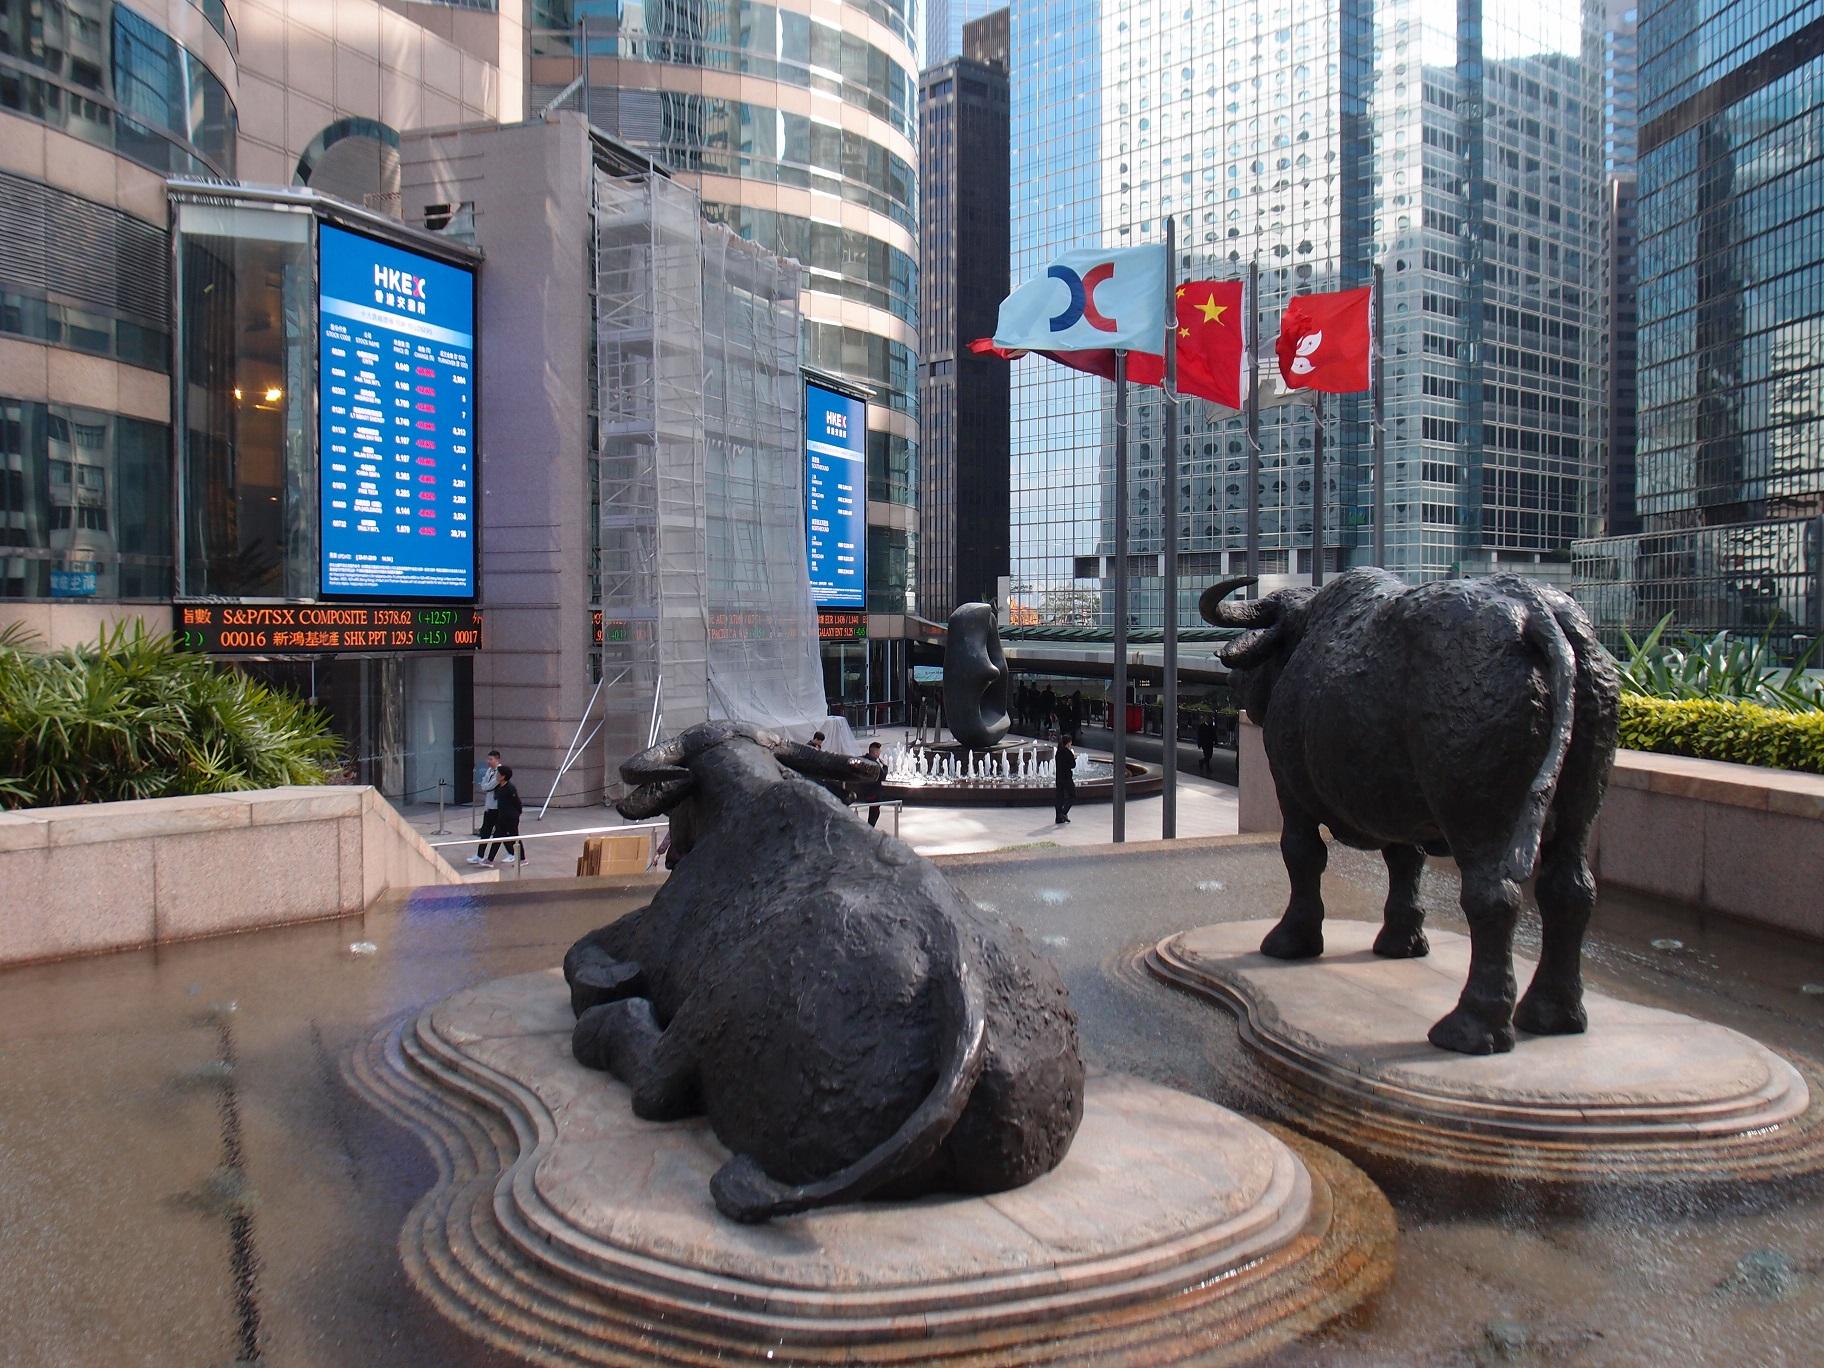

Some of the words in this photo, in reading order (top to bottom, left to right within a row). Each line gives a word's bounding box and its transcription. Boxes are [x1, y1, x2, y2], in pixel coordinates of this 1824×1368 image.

[374, 263, 426, 300] HKEX
[826, 410, 847, 428] HKEX
[223, 609, 295, 625] S&P/TSX
[299, 610, 367, 625] COMPOSITE
[374, 610, 411, 625] 15378.62
[220, 631, 266, 647] 00016
[272, 631, 340, 646] 新鴻基地產
[344, 631, 366, 646] SHK
[368, 632, 387, 646] PPT
[391, 631, 414, 645] 129.5
[455, 630, 478, 644] 00017
